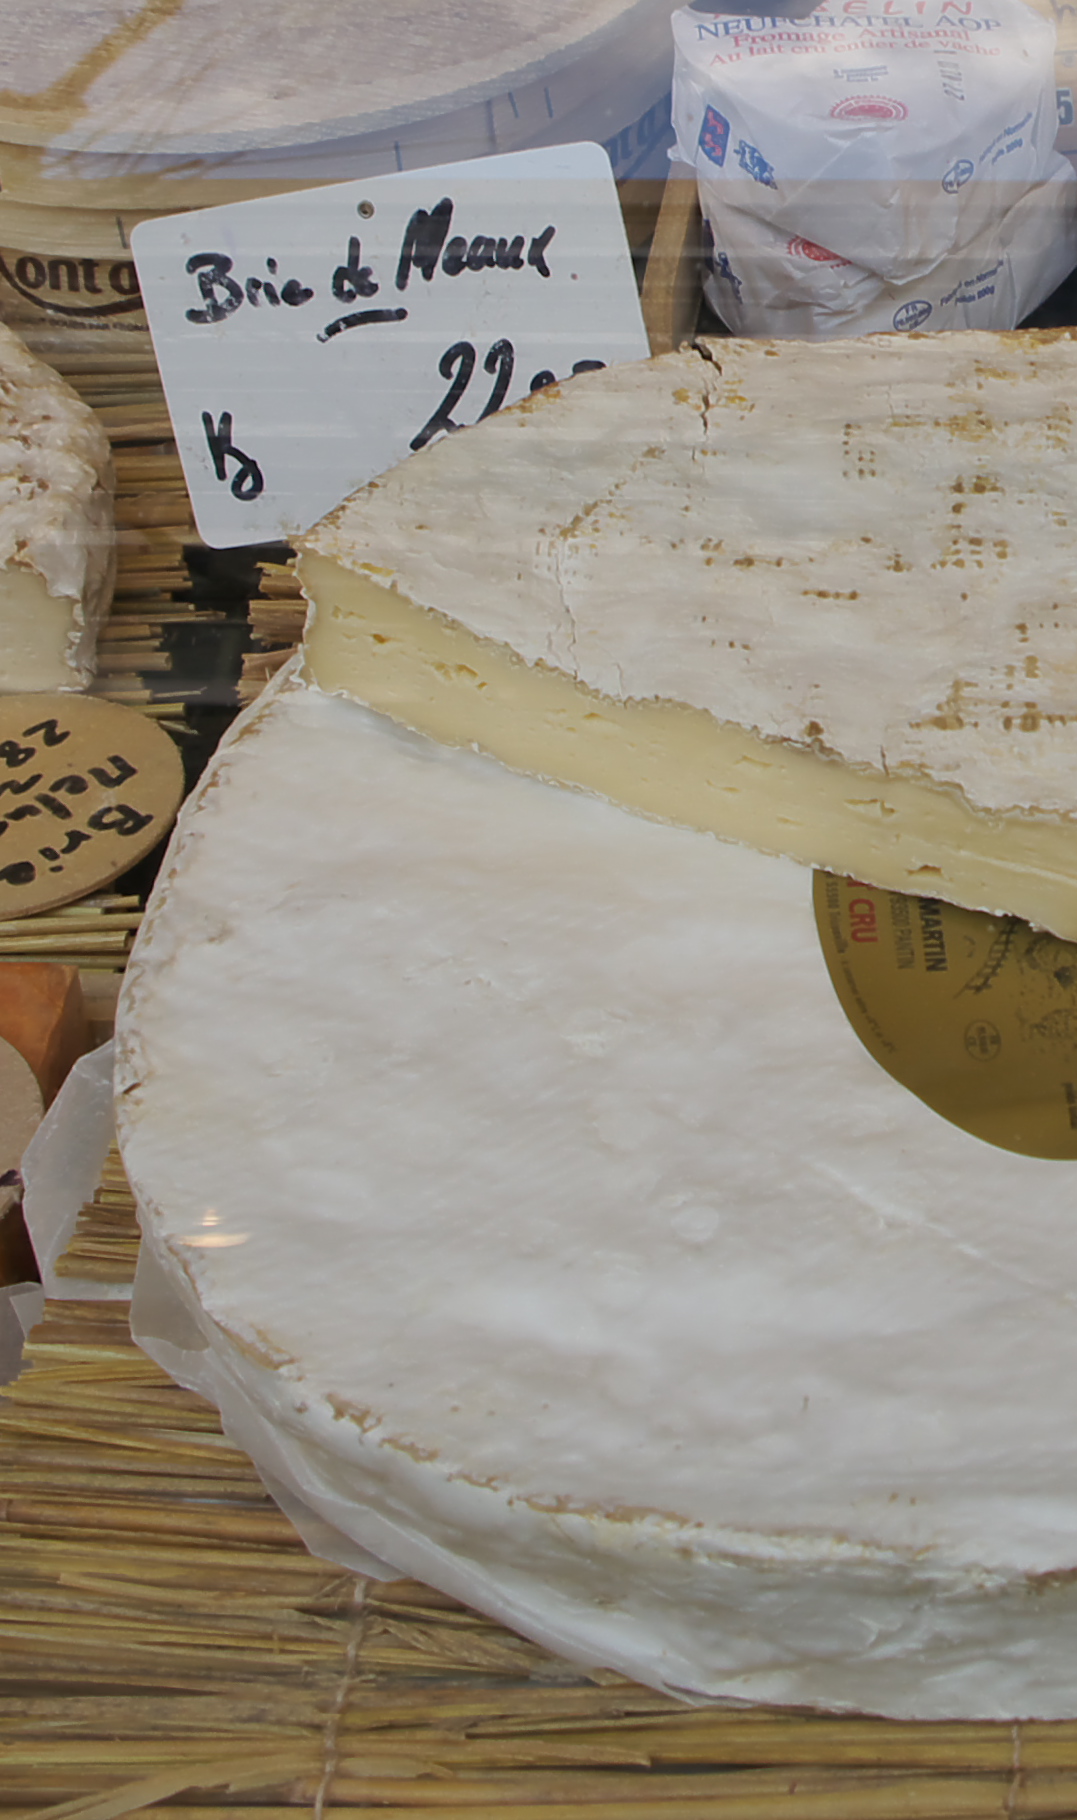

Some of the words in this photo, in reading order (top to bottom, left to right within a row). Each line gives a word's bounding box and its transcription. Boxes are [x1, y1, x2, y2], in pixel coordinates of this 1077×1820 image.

[731, 31, 845, 48] Fromage
[858, 27, 971, 42] Artisanal
[936, 14, 1002, 32] AOP
[710, 52, 742, 67] Au
[748, 43, 785, 57] lait
[791, 45, 826, 55] cru
[833, 39, 898, 53] entier
[904, 39, 931, 49] de
[938, 40, 1001, 56] vache
[185, 252, 315, 324] Brie
[331, 235, 380, 304] de
[395, 197, 557, 292] Meaux
[849, 898, 879, 943] CRU
[918, 897, 948, 973] MARTIN
